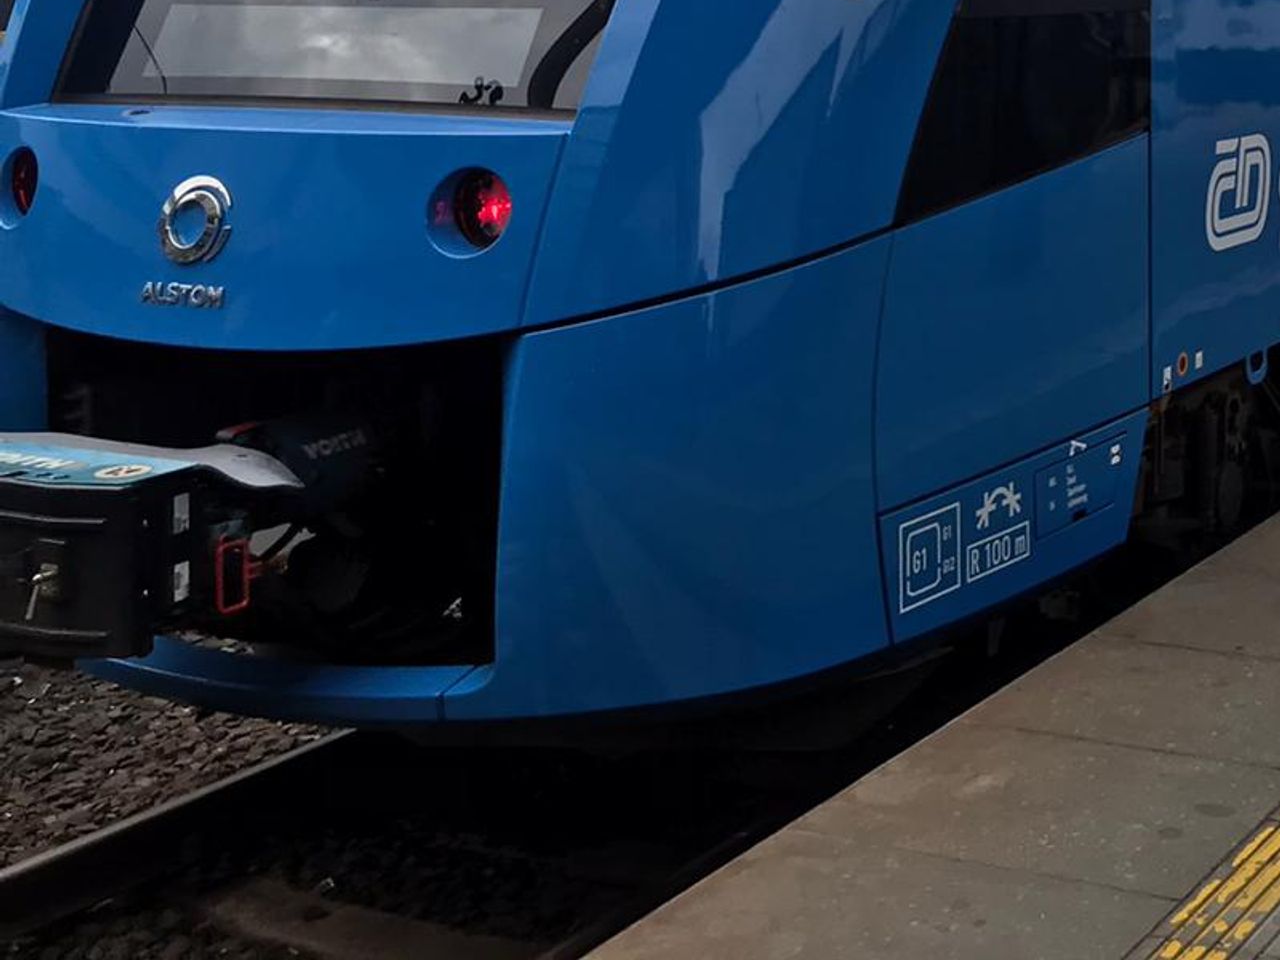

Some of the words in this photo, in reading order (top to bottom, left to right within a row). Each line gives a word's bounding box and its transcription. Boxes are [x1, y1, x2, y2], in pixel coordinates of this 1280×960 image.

[141, 281, 225, 307] ALSTOM
[912, 547, 927, 573] G1
[971, 548, 980, 575] R
[984, 535, 1011, 568] 100
[1014, 534, 1025, 556] m
